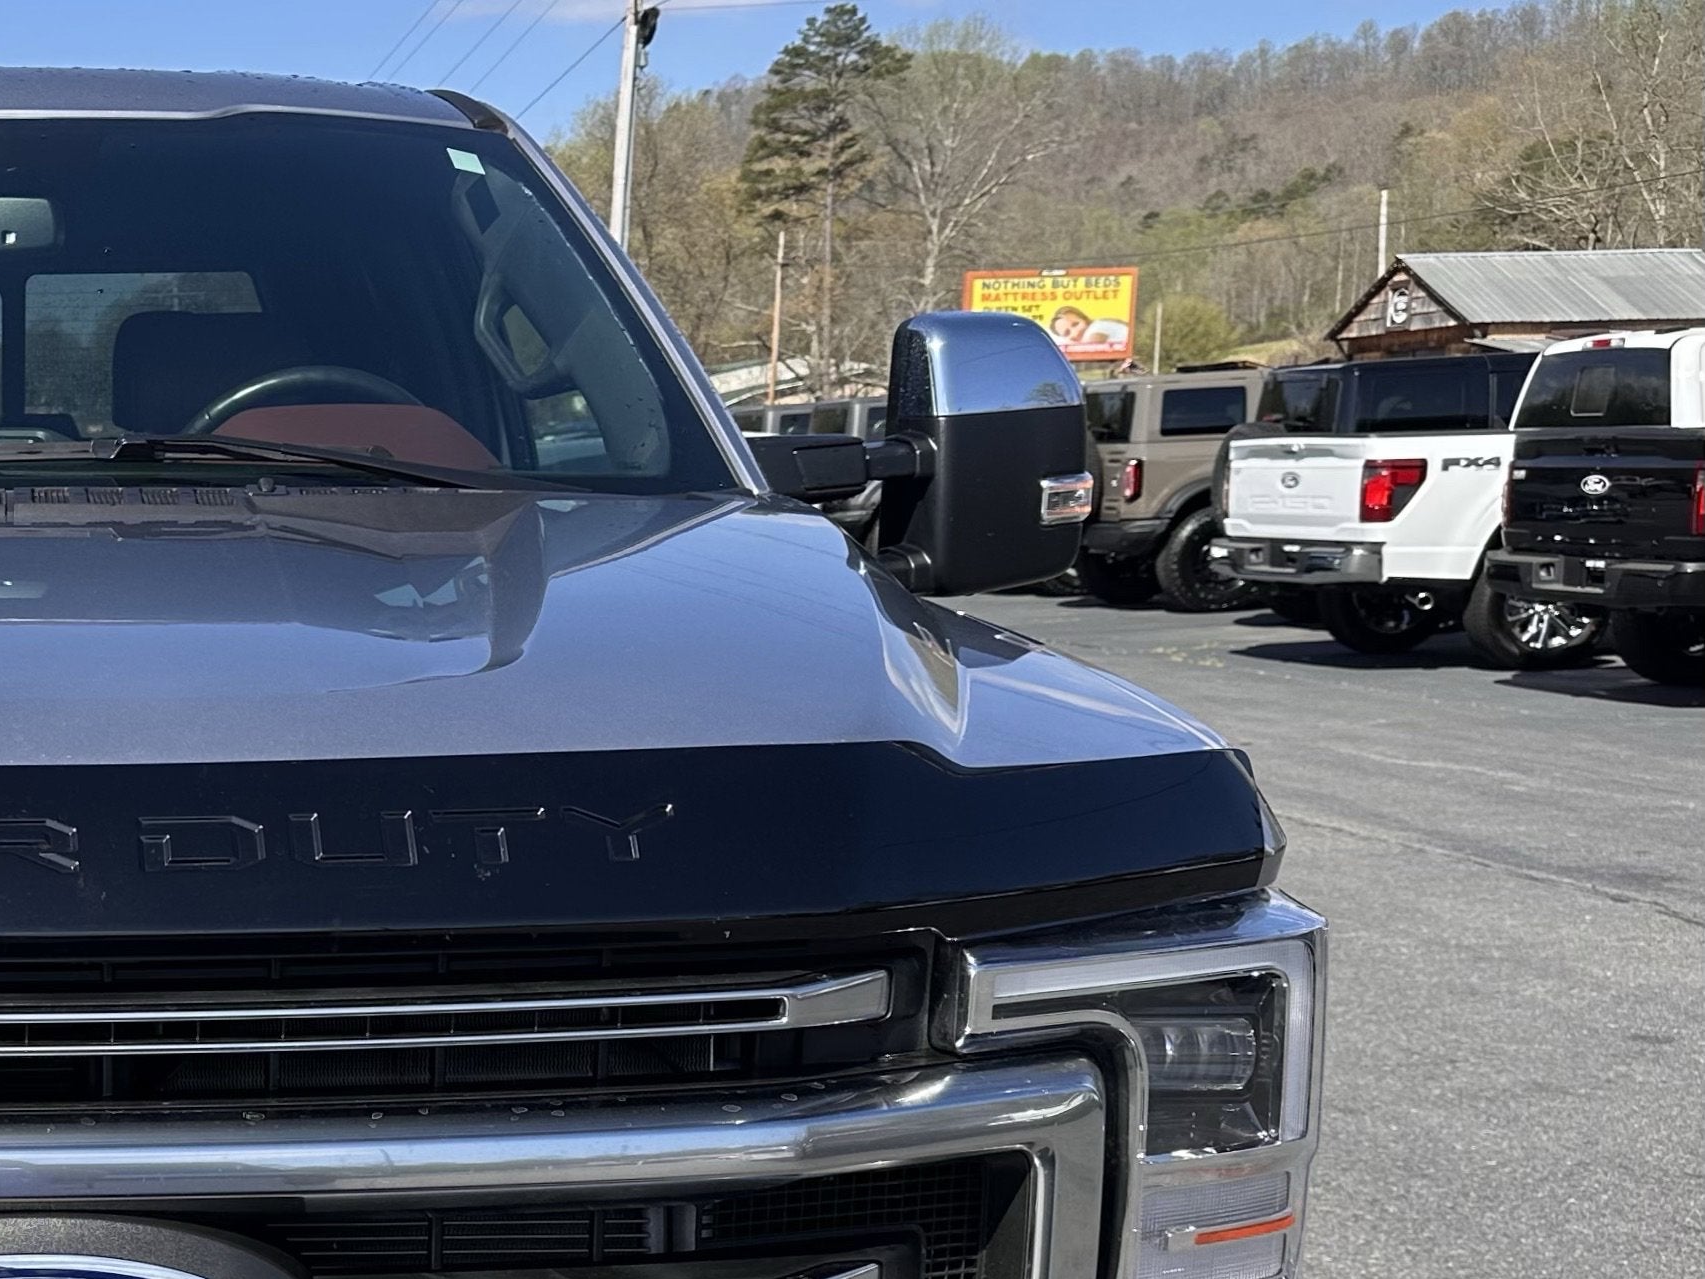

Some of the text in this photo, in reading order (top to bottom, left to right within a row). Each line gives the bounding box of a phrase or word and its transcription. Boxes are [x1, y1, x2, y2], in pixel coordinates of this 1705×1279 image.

[982, 277, 1121, 291] NOTHING BUT BEDS
[982, 289, 1119, 302] MATTRESS OUTLET
[1441, 457, 1501, 471] FX4
[137, 803, 675, 872] DUTY
